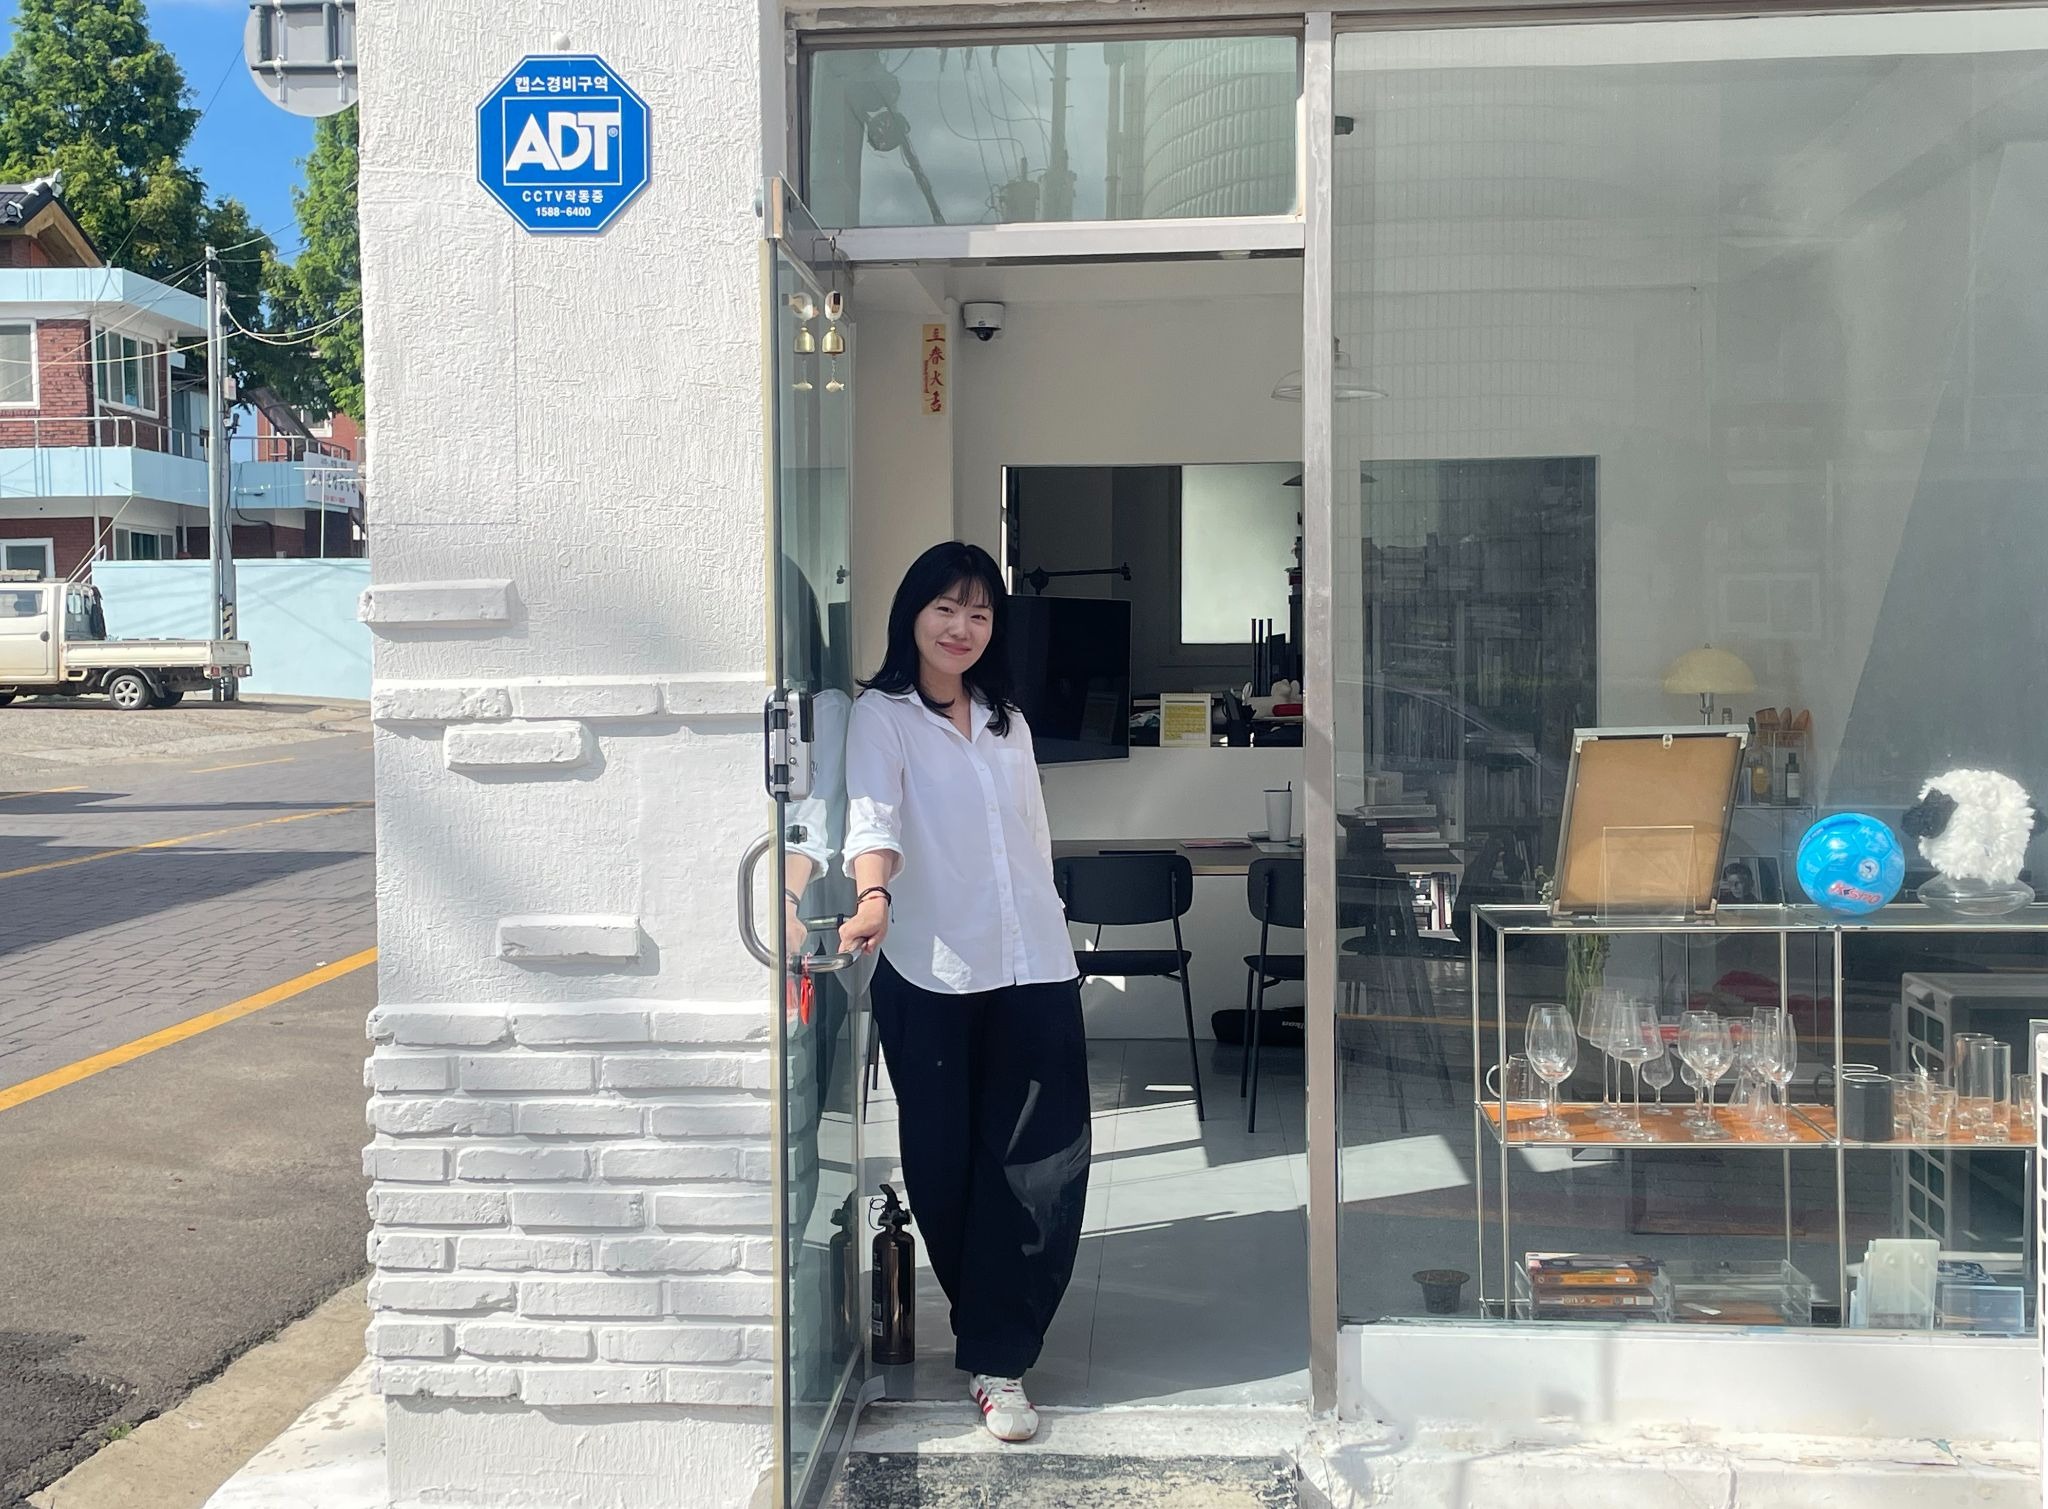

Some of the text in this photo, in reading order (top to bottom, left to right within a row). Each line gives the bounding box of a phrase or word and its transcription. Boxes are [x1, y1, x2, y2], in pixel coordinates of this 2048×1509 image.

[515, 76, 608, 92] 캡스경비구역
[505, 111, 620, 171] ADT
[535, 206, 592, 217] 1588-6400
